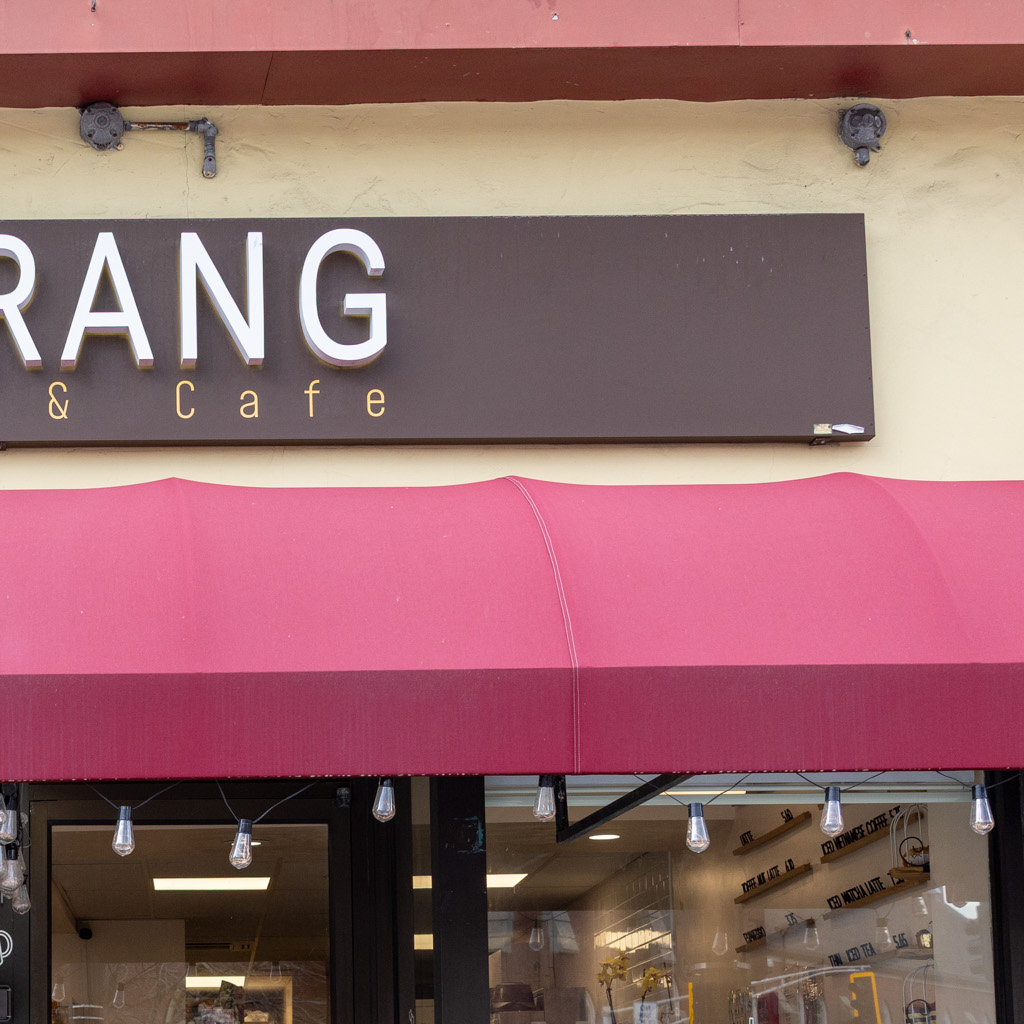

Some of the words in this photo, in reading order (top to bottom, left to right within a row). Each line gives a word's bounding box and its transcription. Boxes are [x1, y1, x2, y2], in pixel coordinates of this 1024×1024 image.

[46, 380, 70, 420] &
[175, 379, 387, 420] Cafe
[821, 840, 835, 856] ICED
[865, 812, 888, 835] COFFEE
[826, 894, 842, 910] ICED
[840, 885, 868, 905] MATCHA
[864, 876, 886, 895] LATTE
[845, 946, 860, 962] ICED
[860, 942, 877, 958] TEA
